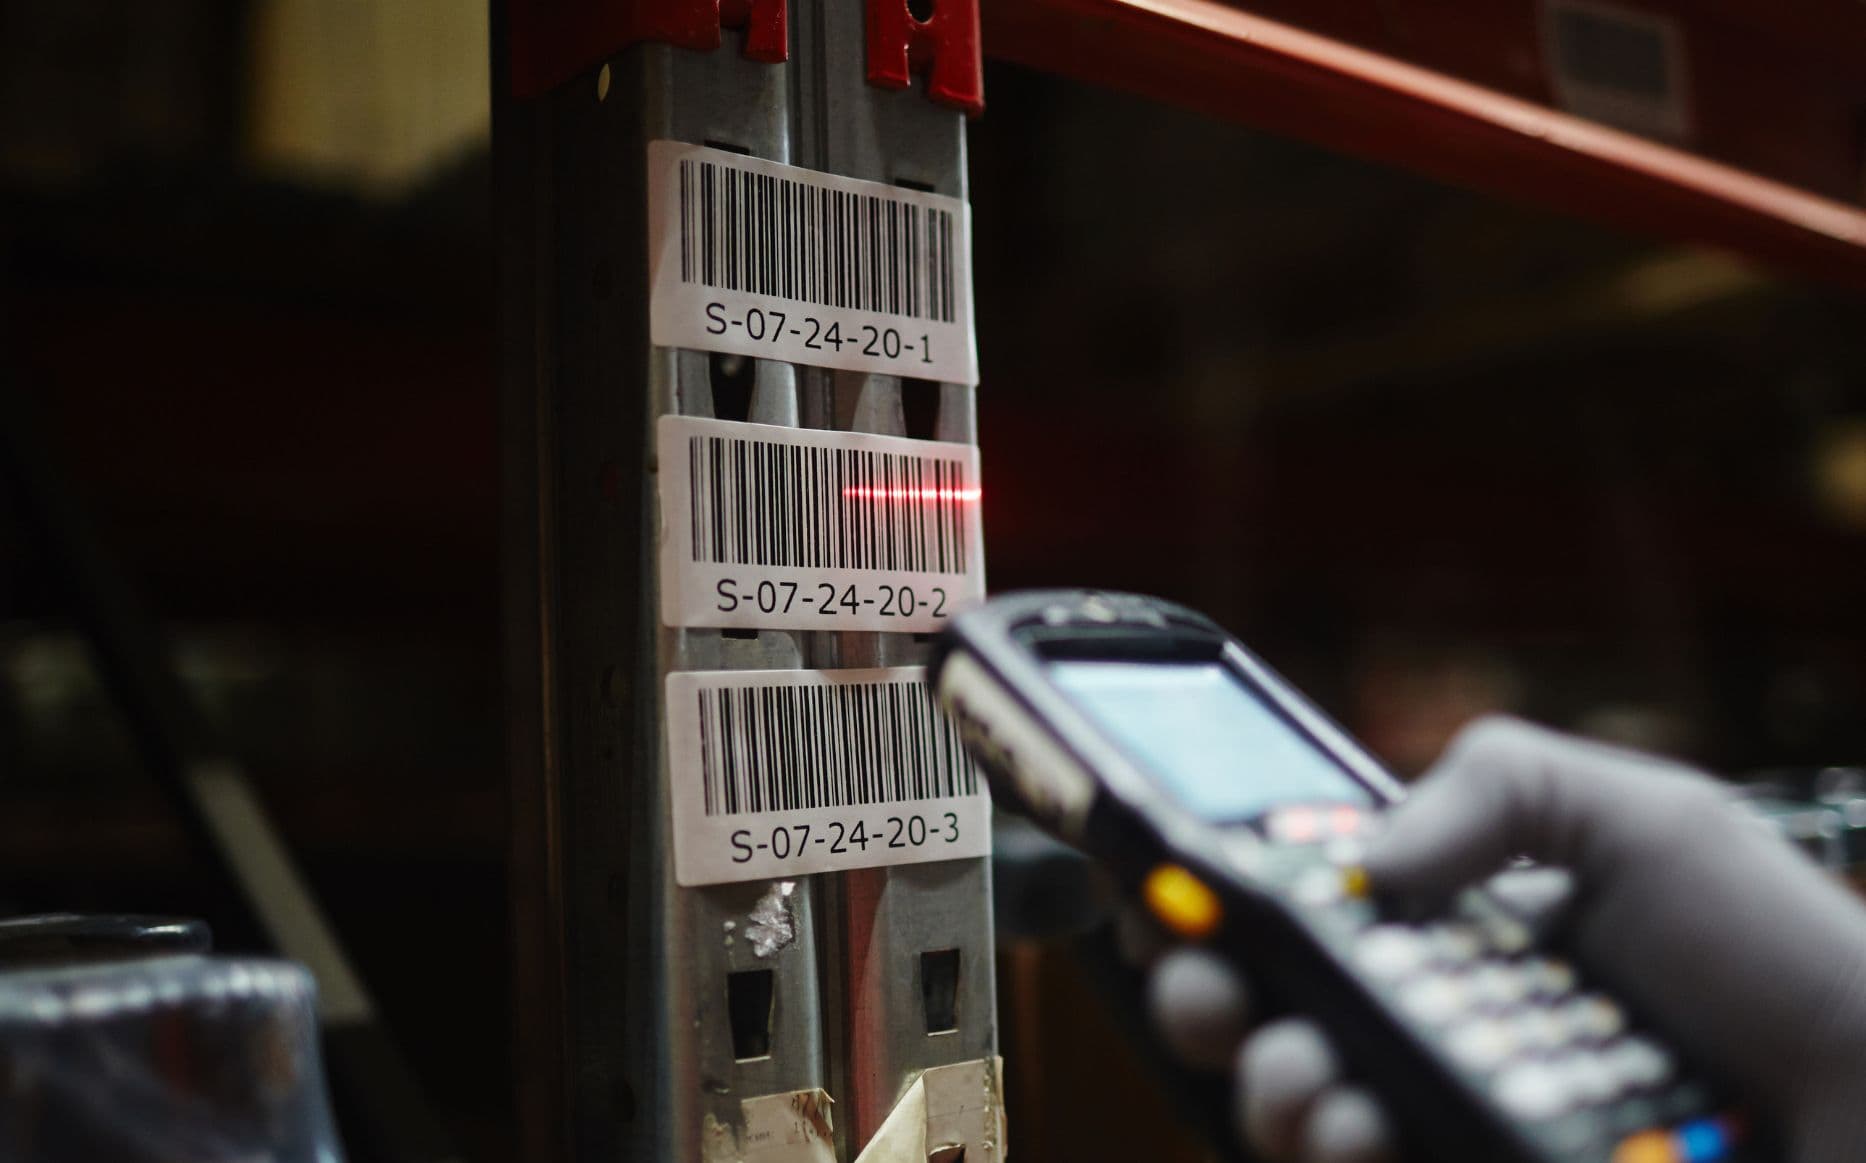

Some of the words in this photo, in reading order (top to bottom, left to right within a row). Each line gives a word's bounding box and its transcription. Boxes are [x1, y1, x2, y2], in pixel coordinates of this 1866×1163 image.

[706, 302, 933, 363] S-07-24-20-1
[717, 579, 947, 617] S-07-24-20-2
[731, 812, 959, 863] S-07-24-20-3
